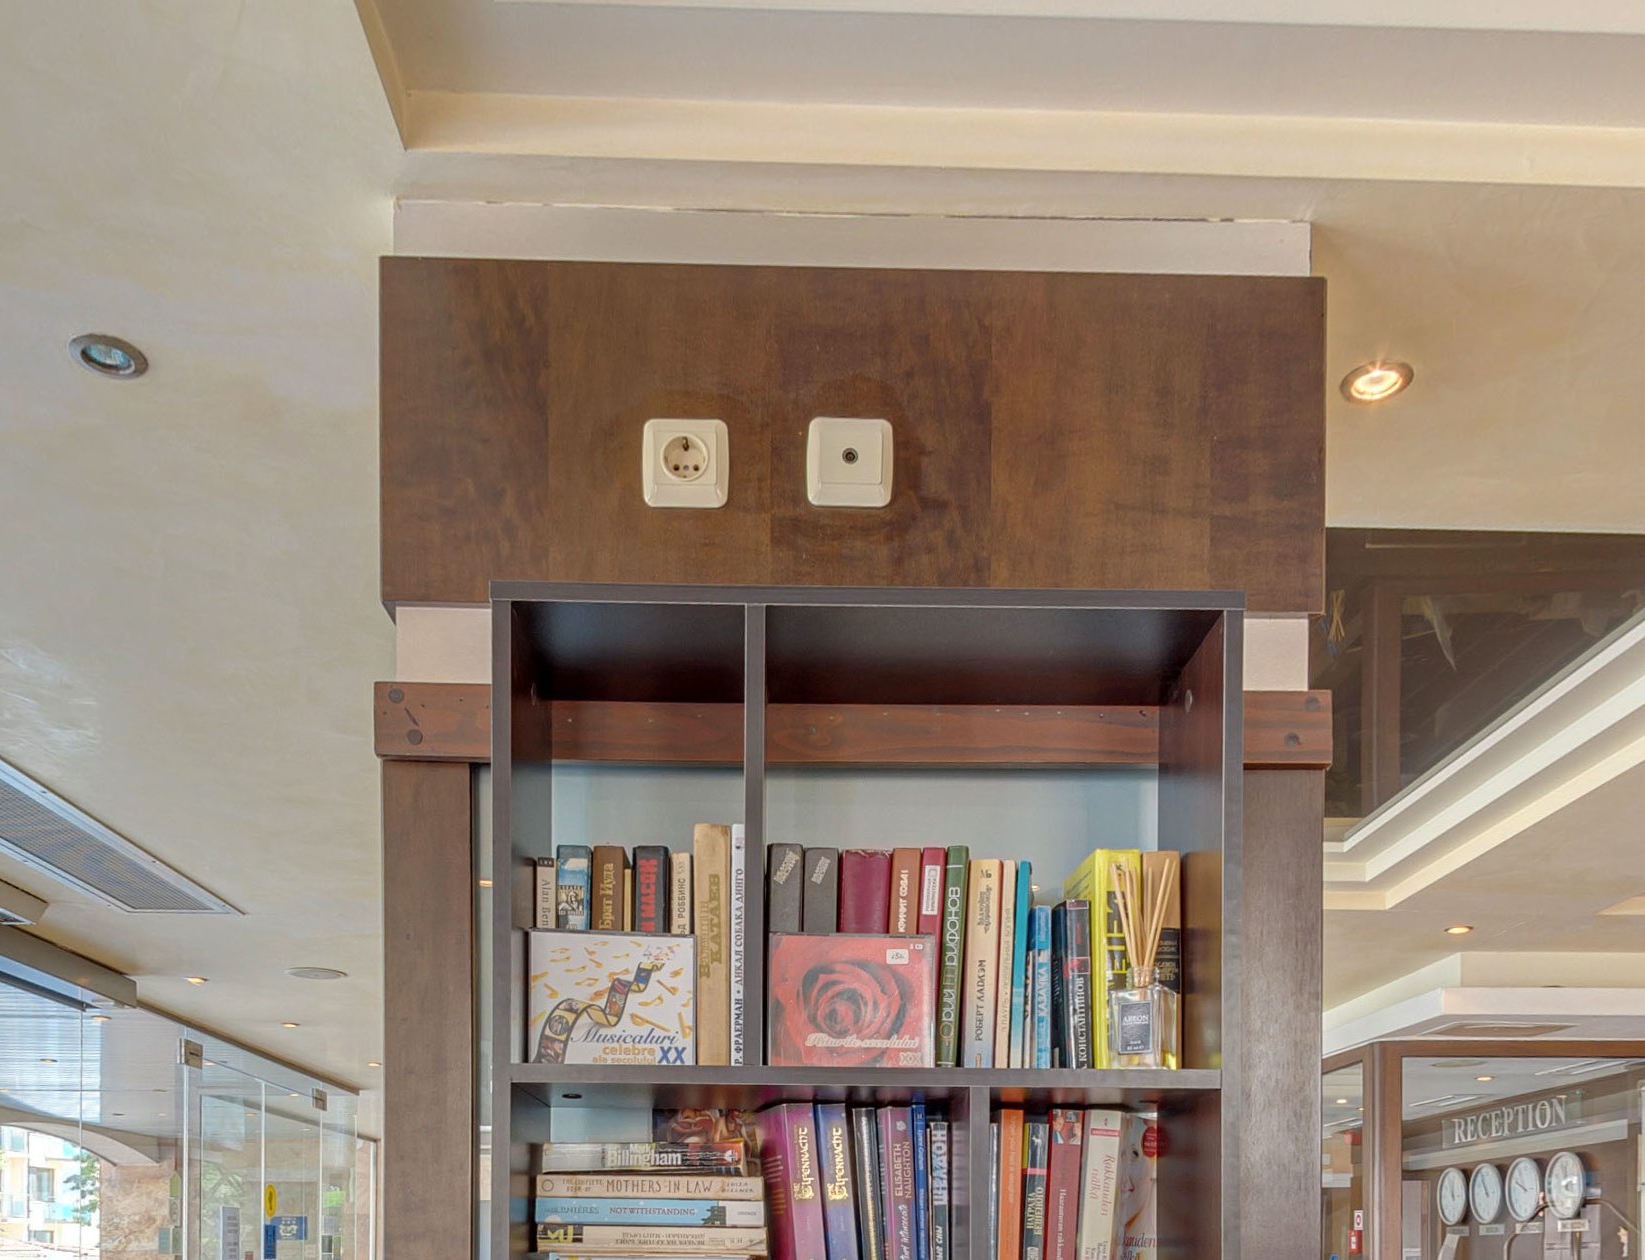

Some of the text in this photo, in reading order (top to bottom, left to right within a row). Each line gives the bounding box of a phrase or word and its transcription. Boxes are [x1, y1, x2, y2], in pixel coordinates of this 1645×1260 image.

[599, 862, 615, 930] Брат Иуда
[639, 859, 658, 919] МАСОК
[677, 877, 686, 918] РОББИНС
[709, 874, 722, 964] КАТАЕВ
[898, 898, 908, 932] КРИЧИТ
[734, 868, 743, 1065] Р. ФРАЕРМАН ДИКАЯ СОБАКА ДИНГО
[975, 959, 987, 1042] РОБЕРТ ЛАДЛЭМ
[1038, 967, 1047, 1018] КАЗАЧКА
[570, 1027, 679, 1045] Musicaluri
[602, 1045, 655, 1056] celebre
[657, 1046, 687, 1064] XX
[592, 1055, 655, 1064] ale secolului
[899, 1052, 923, 1065] XX
[1453, 1096, 1567, 1144] RECEPTION
[607, 1150, 682, 1167] Billingham
[894, 1143, 903, 1197] ELISABETH
[904, 1141, 912, 1199] NAUGHTON
[1101, 1154, 1116, 1217] Rakkauden
[609, 1207, 696, 1216] NOTWITHSTANDING
[1026, 1192, 1035, 1229] НАГРАДА
[1034, 1187, 1043, 1236] БЕШЕНОГО
[935, 1225, 944, 1244] сны
[1123, 1232, 1156, 1248] kauden
